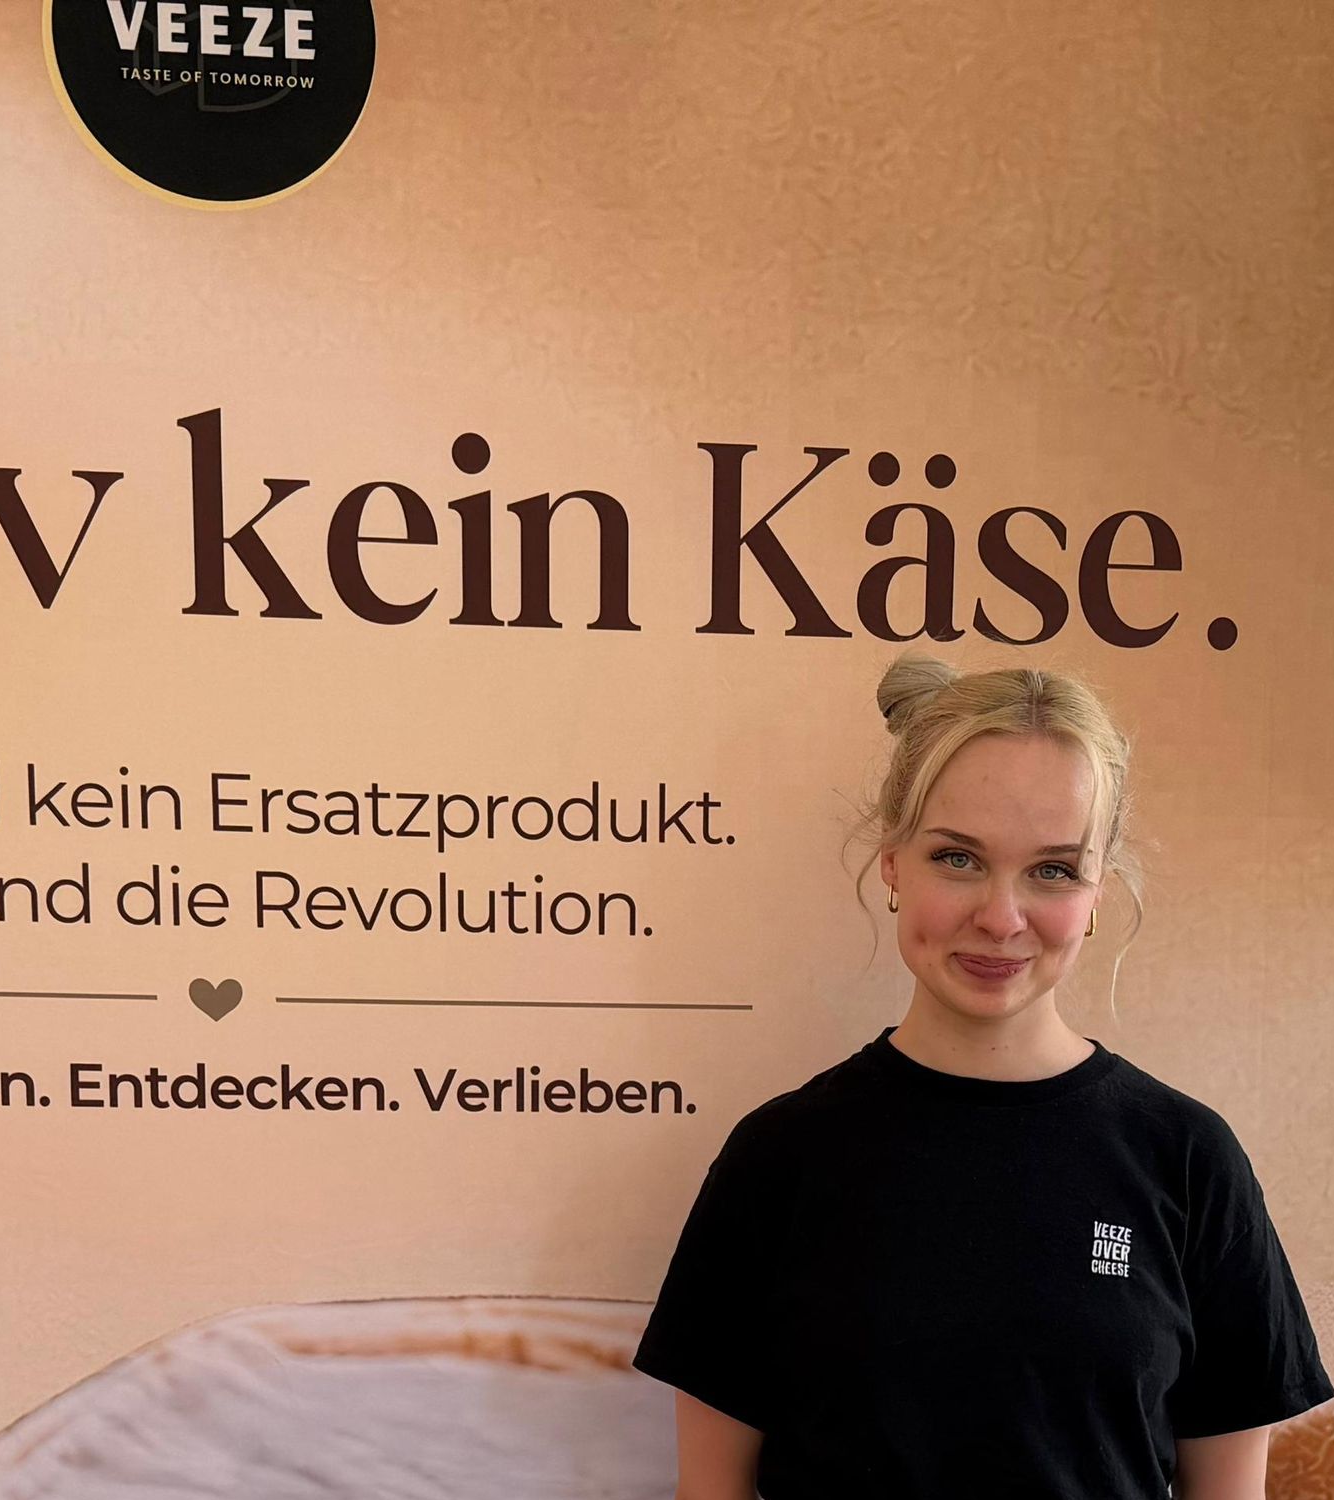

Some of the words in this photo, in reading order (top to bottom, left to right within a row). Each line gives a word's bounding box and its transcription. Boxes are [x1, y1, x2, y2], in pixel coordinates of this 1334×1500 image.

[107, 0, 316, 60] VEEZE
[120, 67, 171, 82] TASTE
[180, 70, 202, 83] OF
[209, 71, 315, 89] TOMORROW
[176, 407, 641, 632] kein
[695, 442, 1239, 649] Käse.
[27, 762, 182, 830] kein
[211, 772, 736, 853] Ersatzprodukt.
[116, 863, 229, 927] die
[255, 871, 653, 936] Revolution.
[70, 1063, 400, 1111] Entdecken.
[414, 1066, 697, 1114] Verlieben.
[1092, 1239, 1130, 1262] OVER
[1094, 1221, 1132, 1243] VEEZE
[1091, 1259, 1129, 1277] CHEESE
